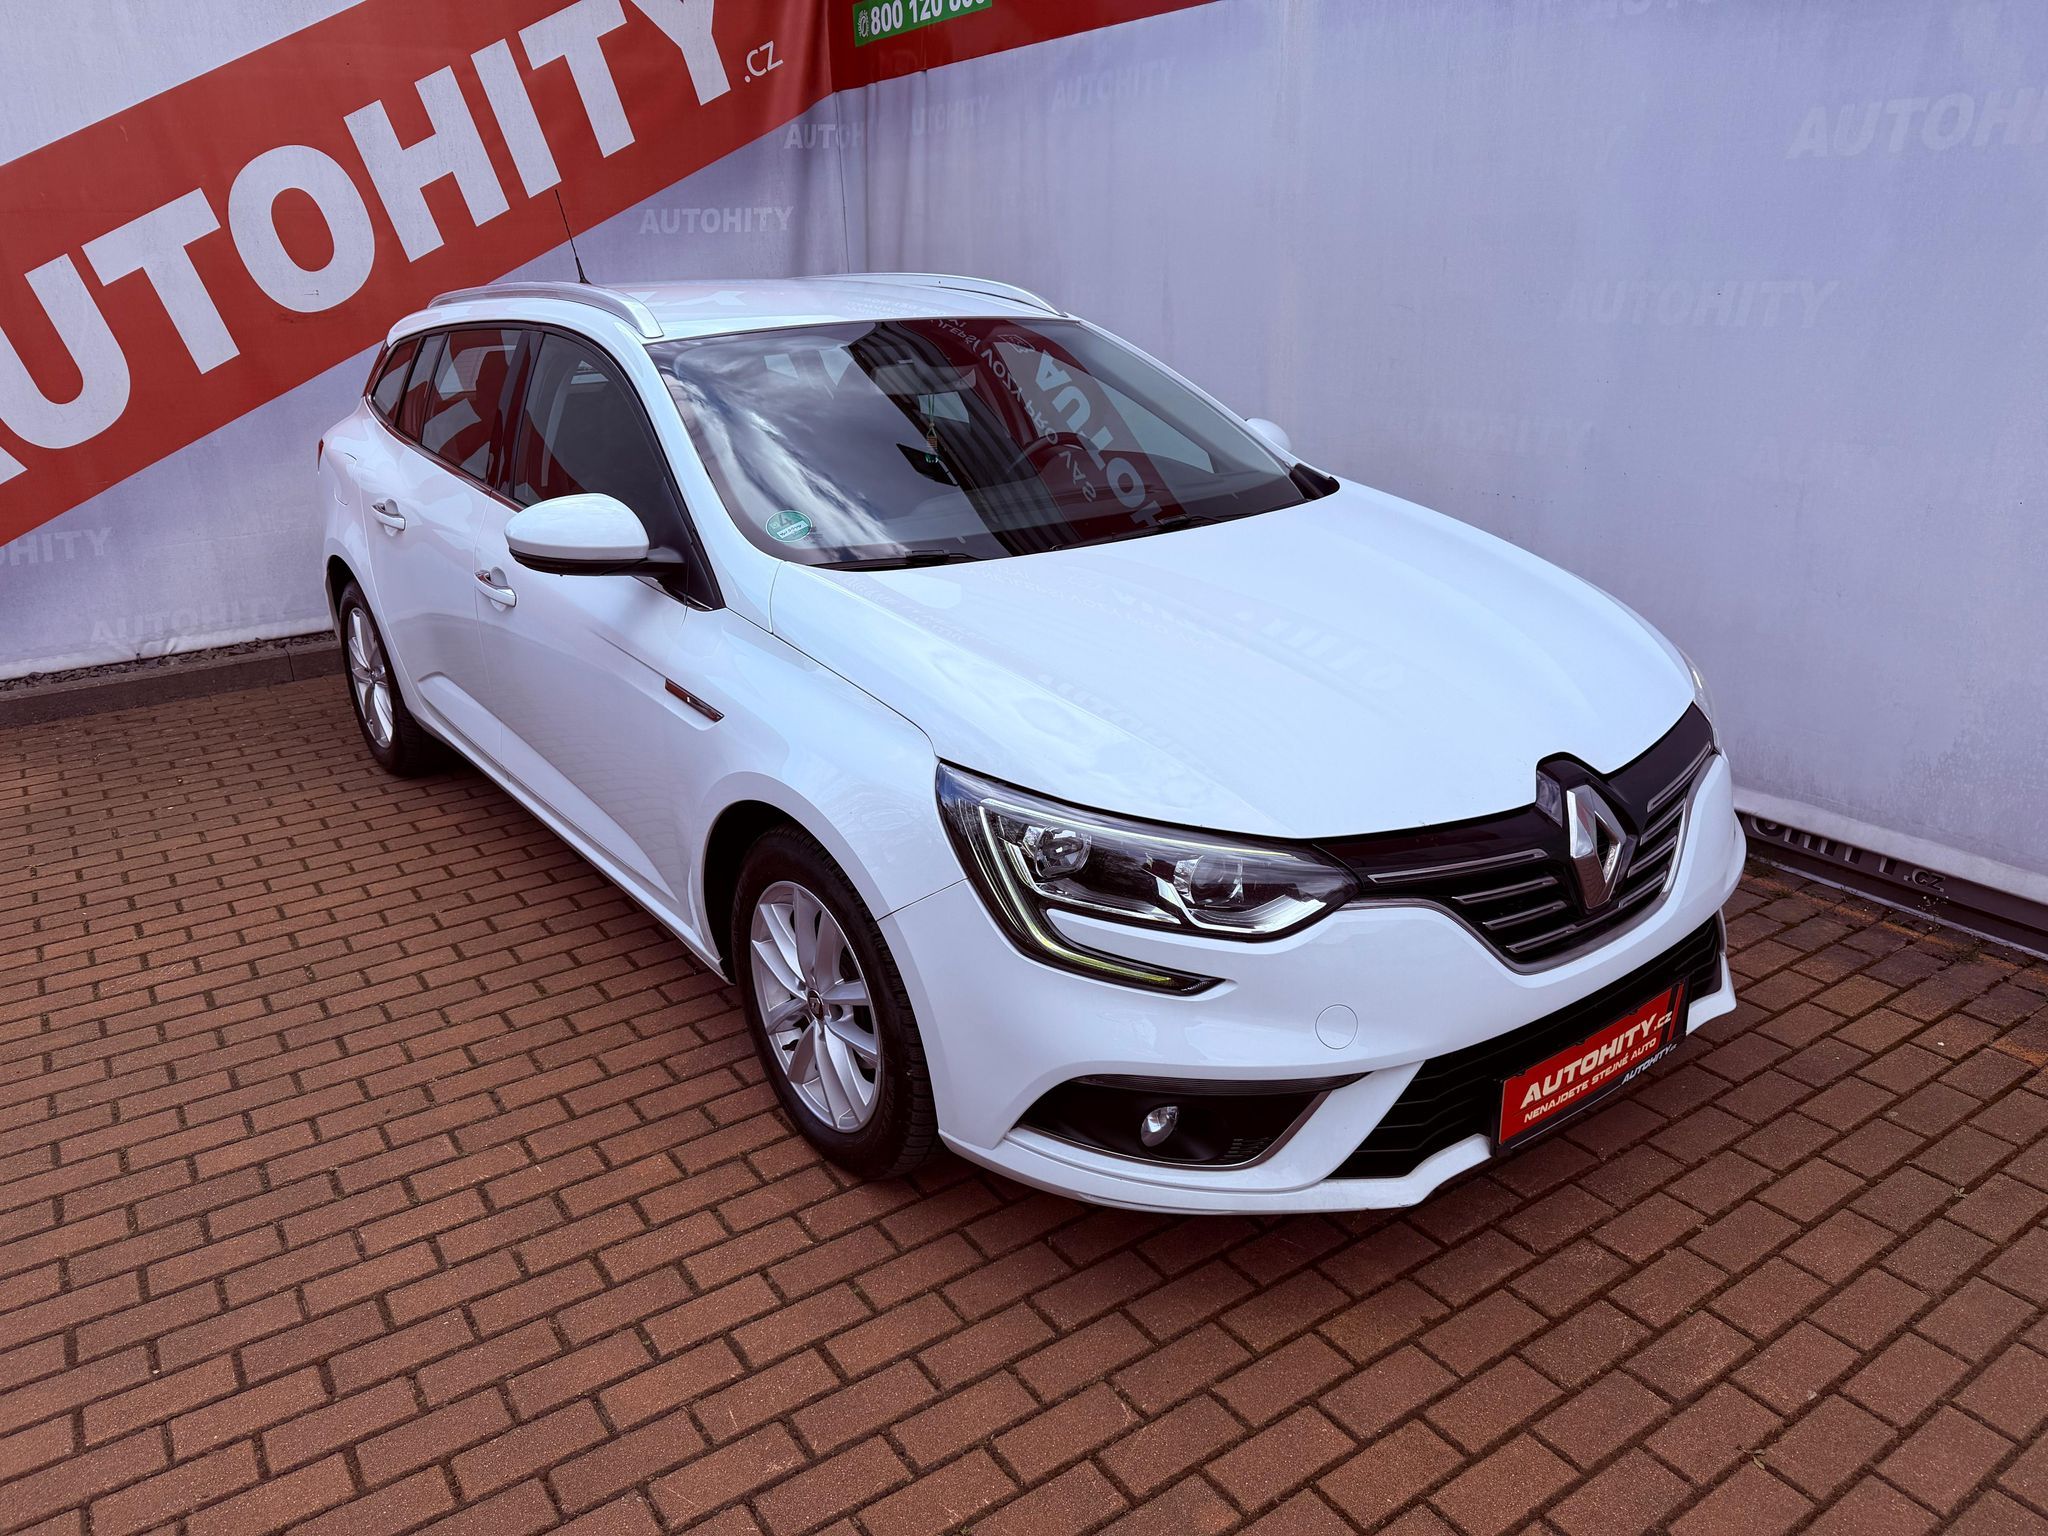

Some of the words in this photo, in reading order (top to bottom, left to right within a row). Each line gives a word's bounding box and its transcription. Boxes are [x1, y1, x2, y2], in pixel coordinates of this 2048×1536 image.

[870, 0, 903, 35] 800
[909, 0, 943, 23] 120
[911, 95, 990, 136] UTOHITY
[639, 206, 794, 235] AUTOHITY
[0, 0, 731, 485] UTOHITY
[1555, 280, 1841, 329] AUTOHITY
[0, 527, 112, 566] HITY
[1523, 1080, 1590, 1123] NENAJDETE
[1630, 1037, 1657, 1061] AUTO
